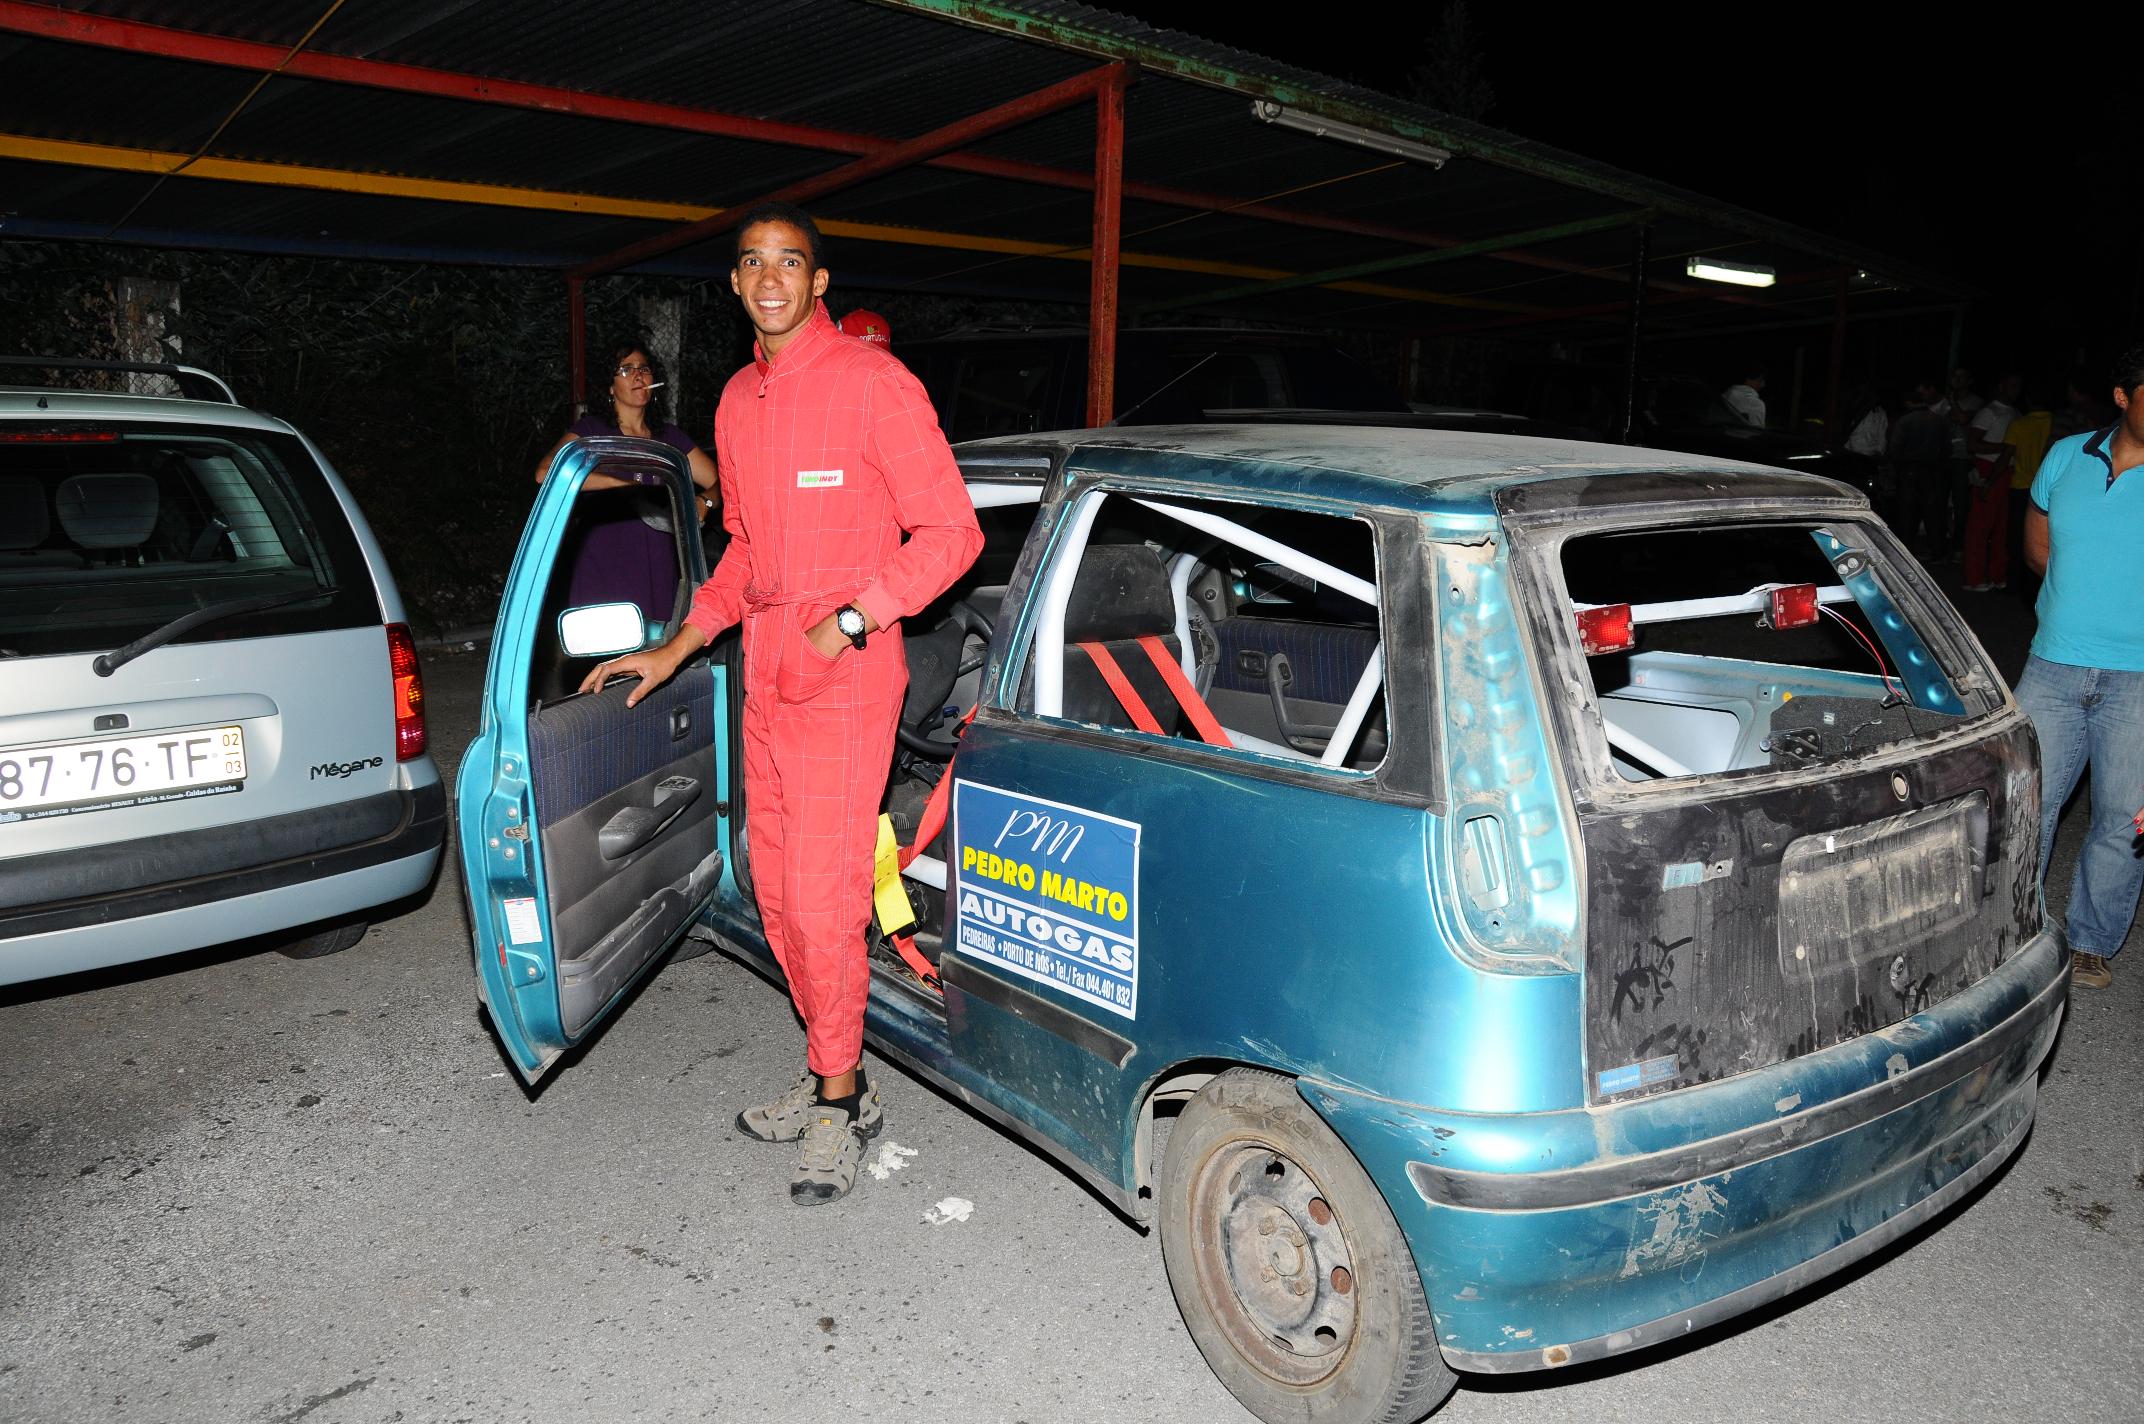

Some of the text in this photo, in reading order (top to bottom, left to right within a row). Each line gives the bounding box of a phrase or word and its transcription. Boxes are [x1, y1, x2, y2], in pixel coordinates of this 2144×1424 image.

[222, 733, 240, 747] 02
[225, 760, 242, 774] 03
[310, 756, 383, 780] Mégane
[963, 845, 1128, 921] PEDRO MARTO
[961, 892, 1134, 971] AUTOGAS
[962, 925, 996, 952] PEDREIRAS
[1002, 942, 1024, 966] PORTO
[1025, 951, 1034, 969] DE
[1035, 950, 1050, 972] NÓS
[1072, 967, 1085, 989] Fax
[1116, 984, 1131, 1007] 832
